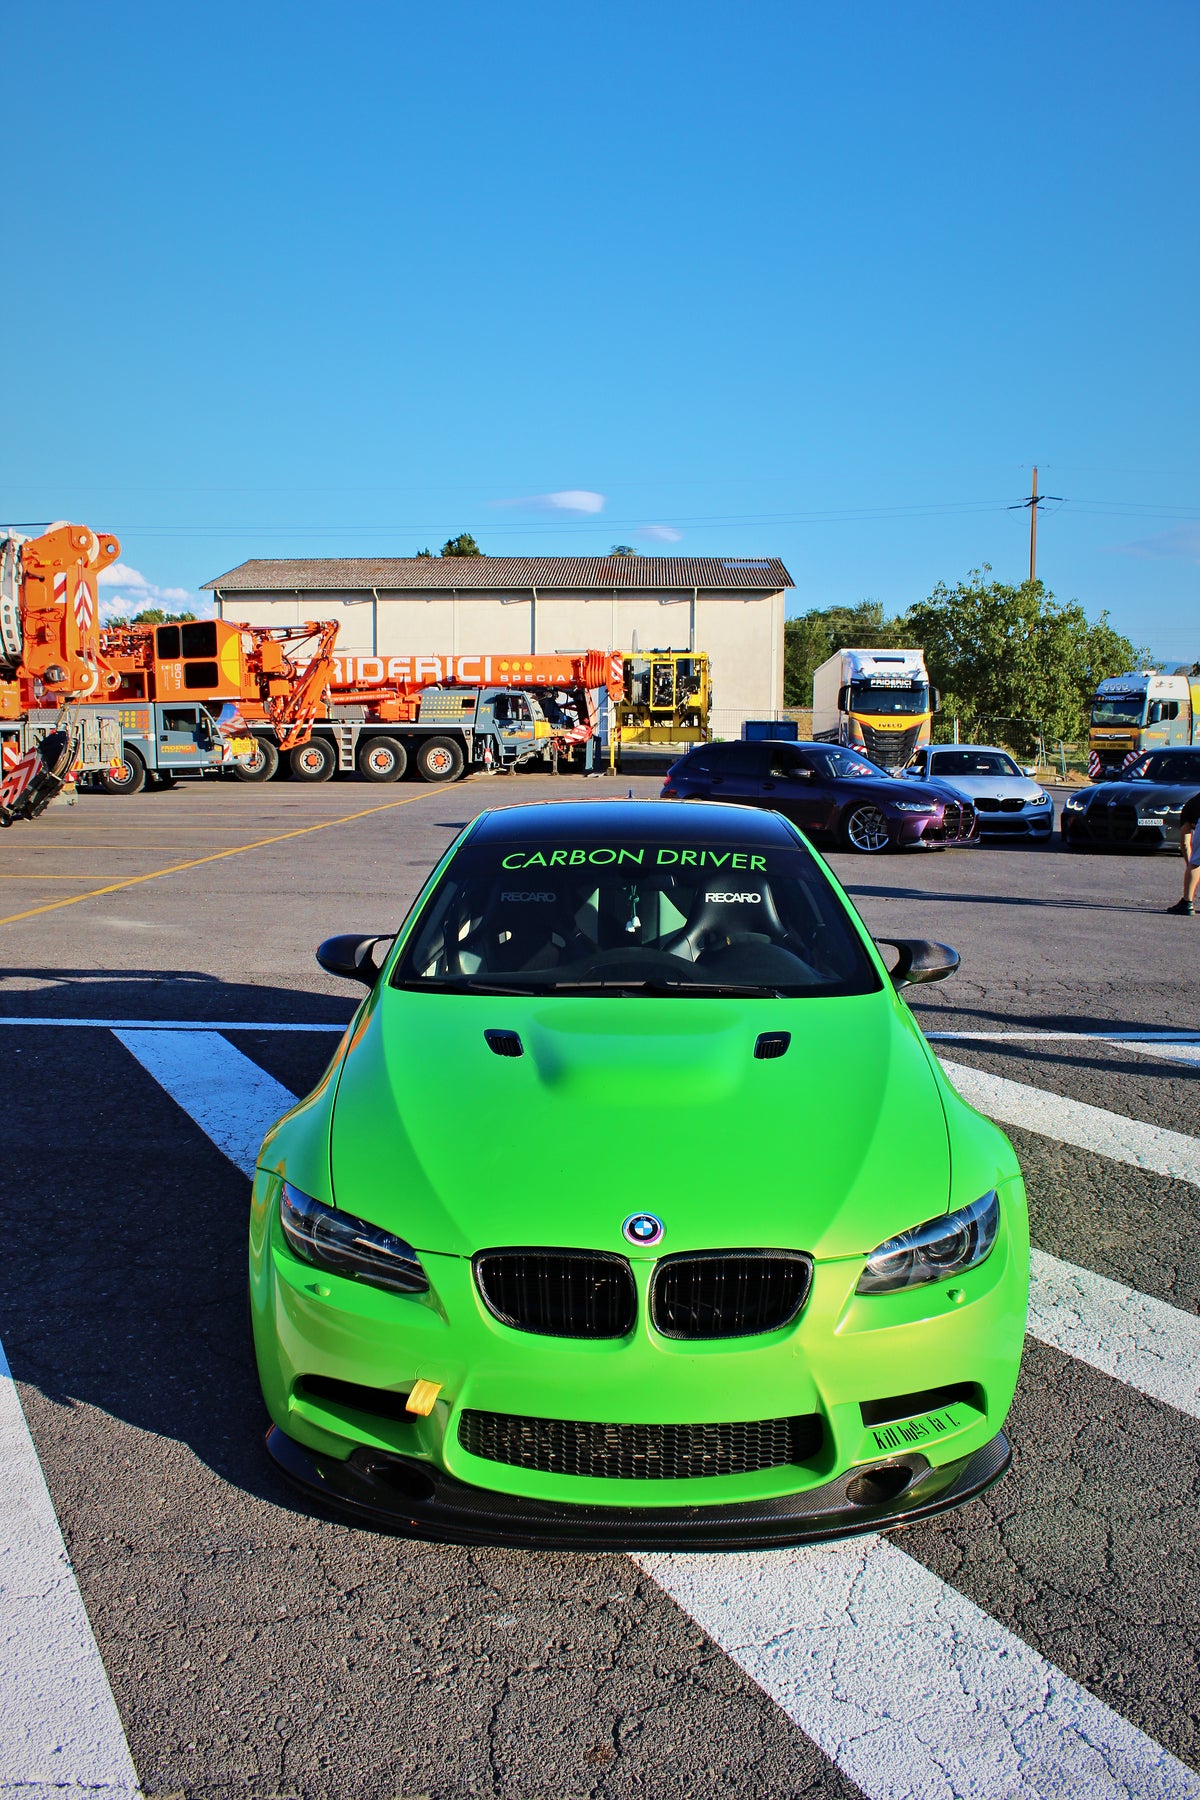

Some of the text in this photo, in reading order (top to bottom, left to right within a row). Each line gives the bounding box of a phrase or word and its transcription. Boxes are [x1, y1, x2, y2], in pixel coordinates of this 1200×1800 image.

[501, 849, 768, 872] CARBON DRIVER
[501, 892, 557, 903] RECARO
[705, 892, 761, 904] RECARO
[872, 1427, 901, 1450] Kill
